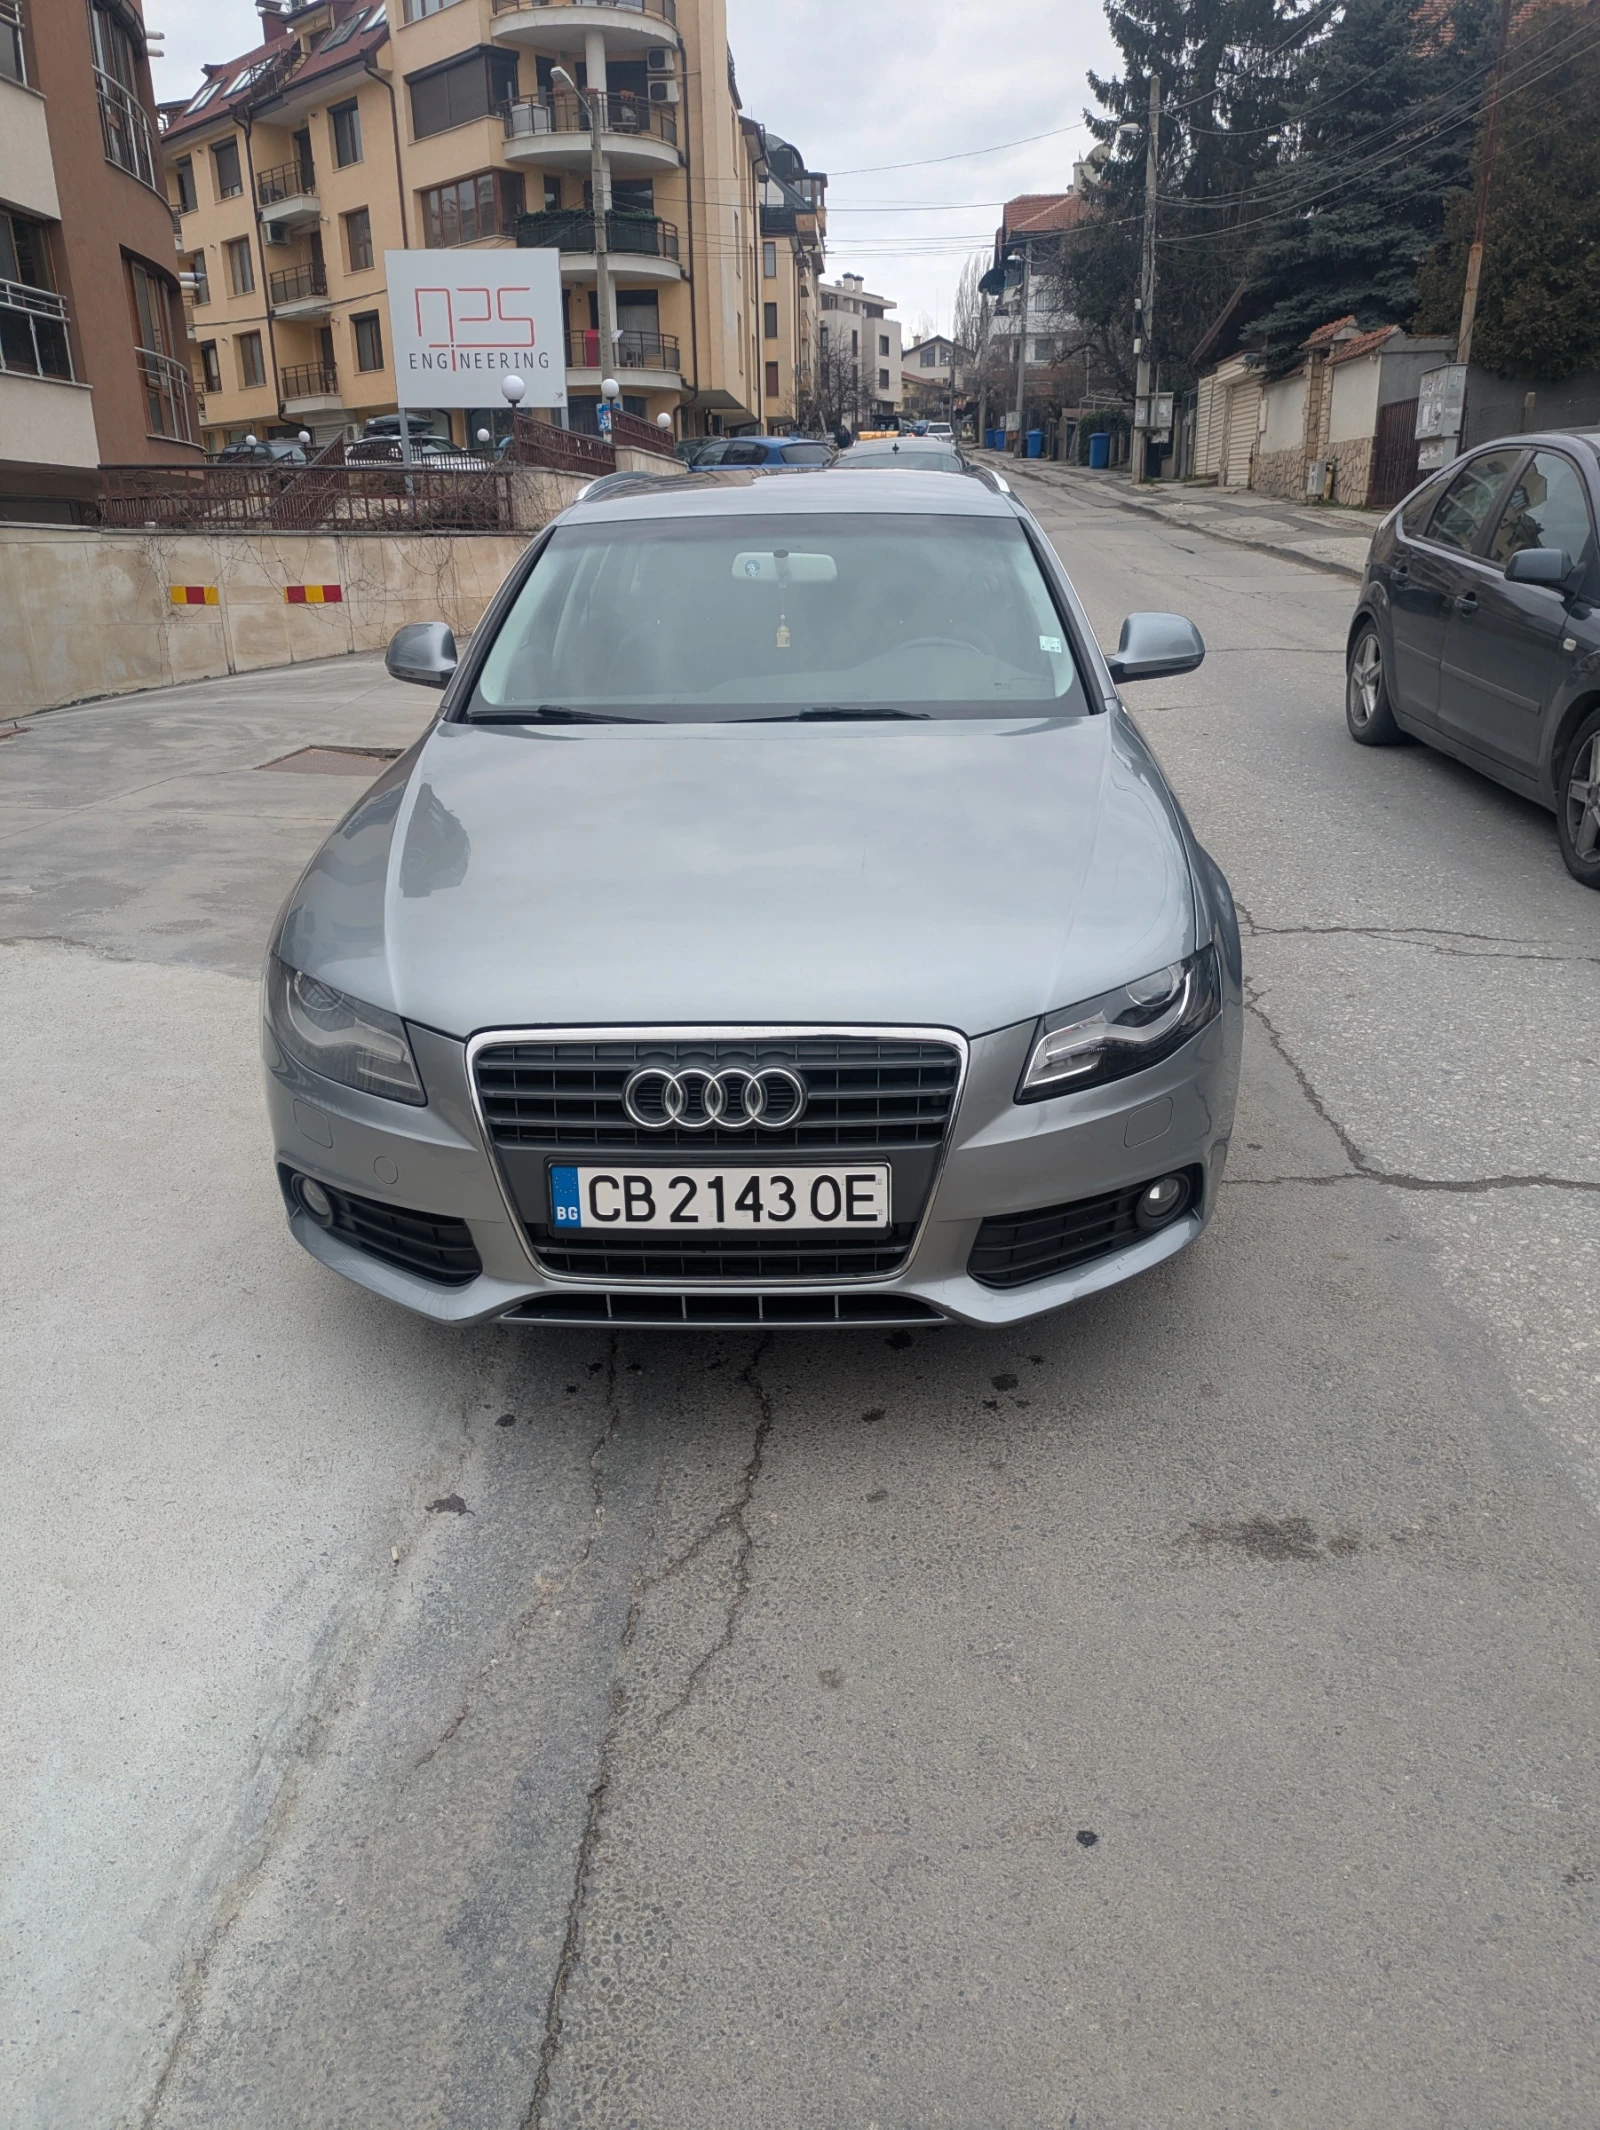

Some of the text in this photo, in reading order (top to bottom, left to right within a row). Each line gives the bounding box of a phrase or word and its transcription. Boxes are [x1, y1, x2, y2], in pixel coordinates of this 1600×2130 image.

[409, 352, 549, 371] ENGINEERING
[588, 1174, 878, 1222] CB 2143 OE
[557, 1206, 578, 1221] BG
